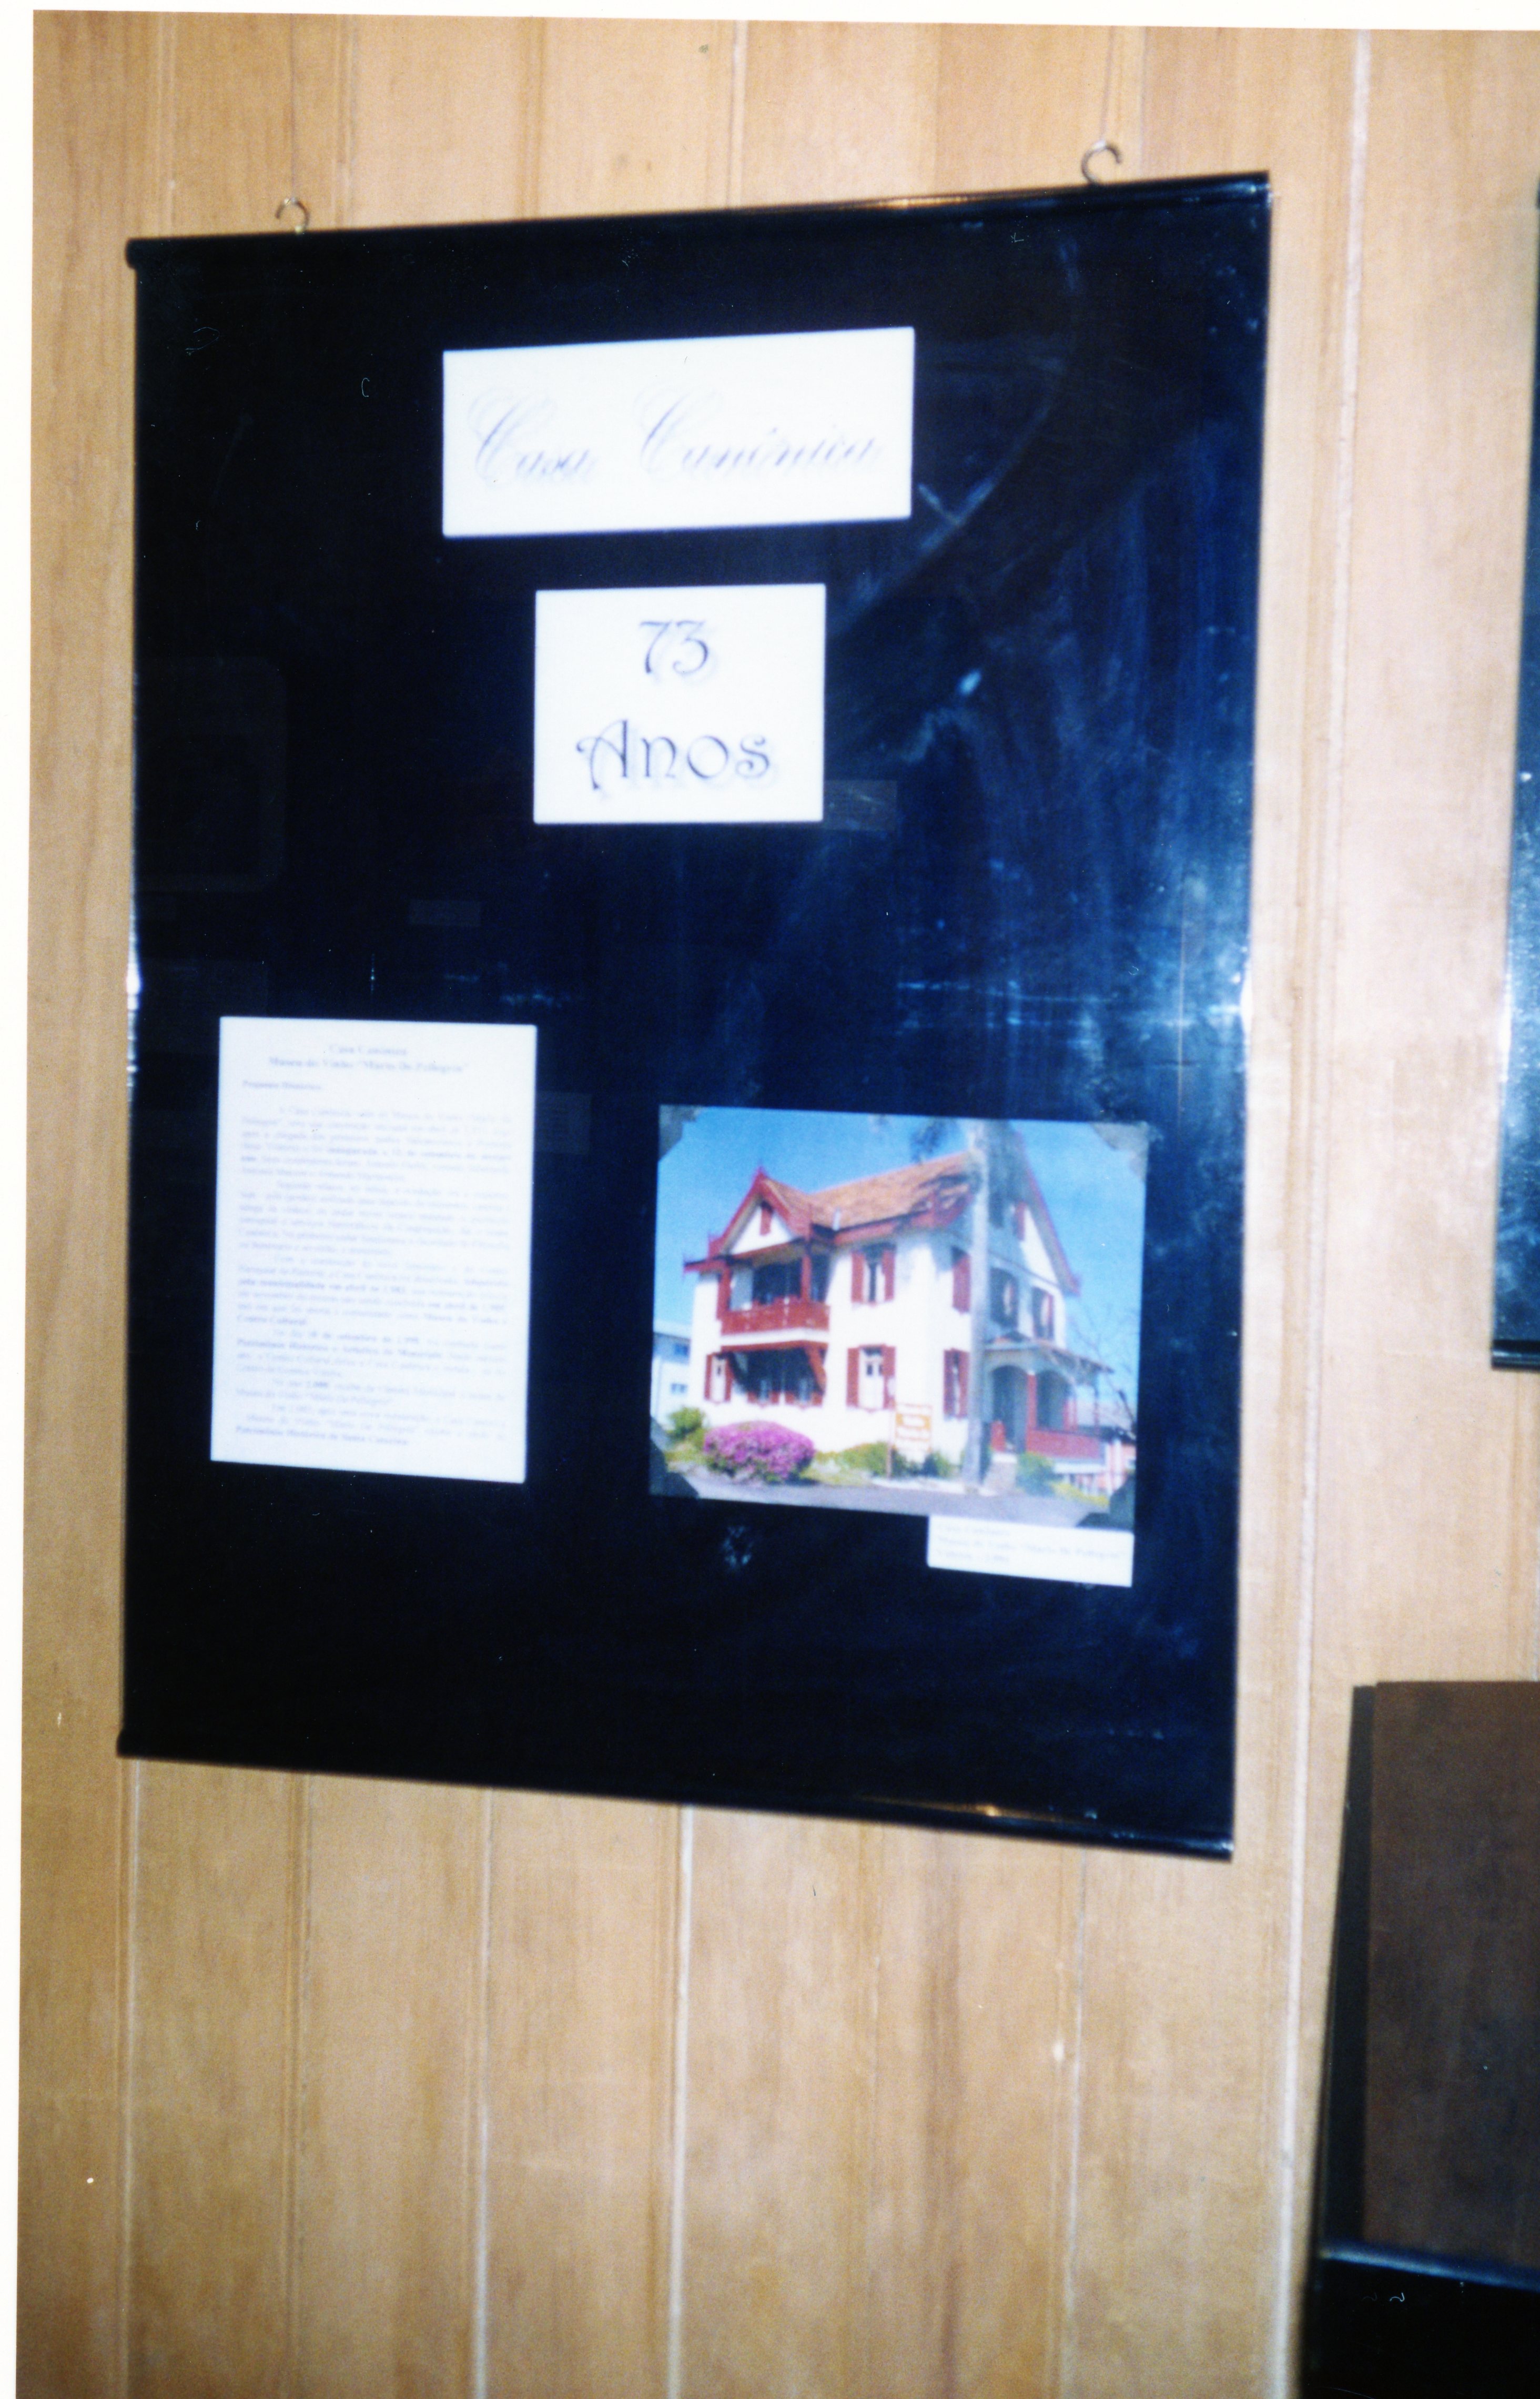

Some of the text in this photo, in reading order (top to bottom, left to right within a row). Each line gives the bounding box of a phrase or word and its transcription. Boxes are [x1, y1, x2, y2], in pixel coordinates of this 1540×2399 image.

[470, 388, 600, 487] Casa
[639, 619, 712, 678] 73
[575, 719, 775, 791] Anos
